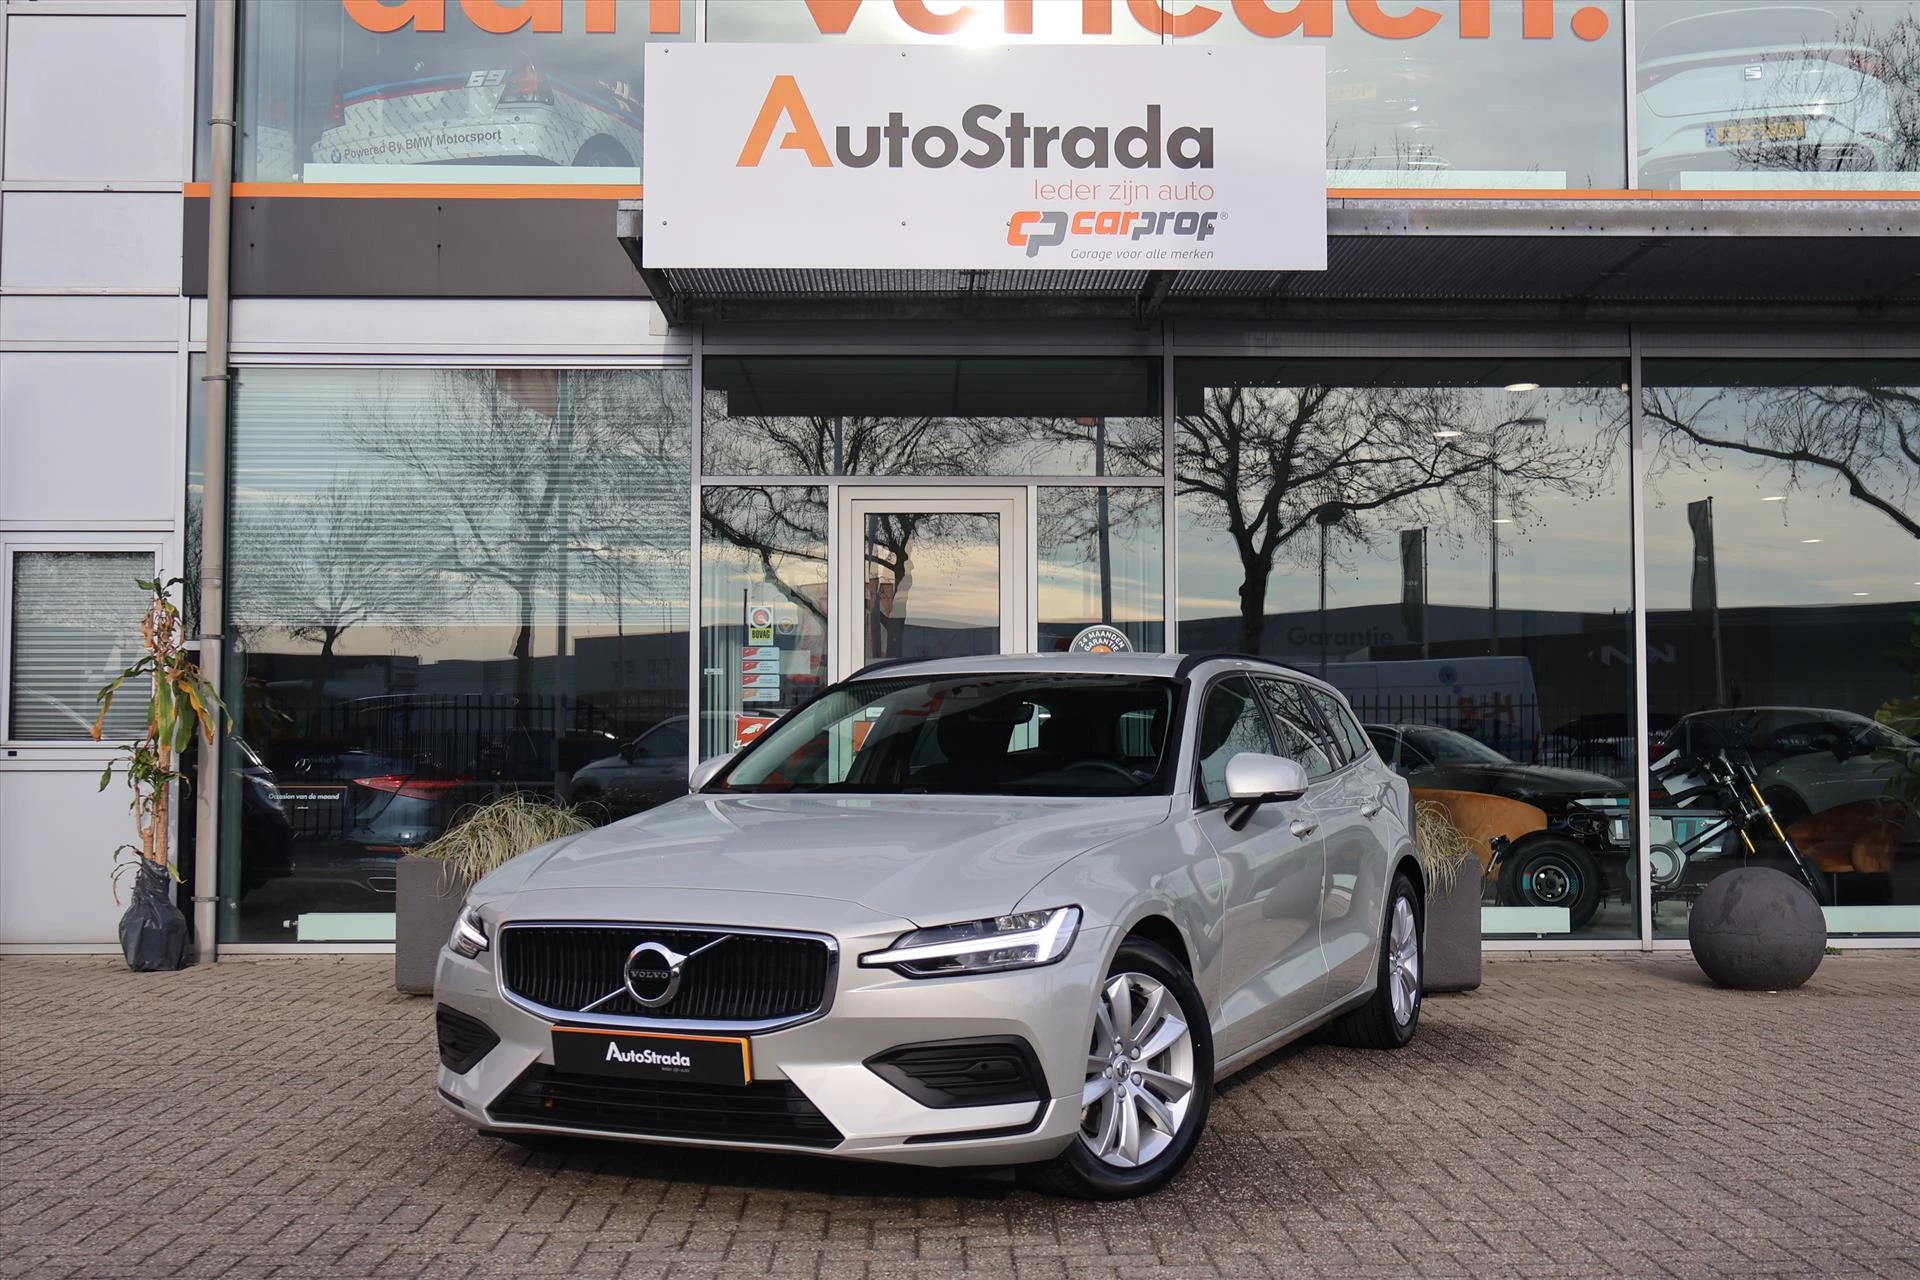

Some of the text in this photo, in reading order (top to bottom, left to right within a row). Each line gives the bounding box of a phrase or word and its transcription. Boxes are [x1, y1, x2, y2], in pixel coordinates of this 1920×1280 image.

[466, 70, 506, 87] 69
[736, 75, 1214, 170] AutoStrada
[343, 129, 503, 160] Powered By BMW Motorsport
[1034, 179, 1215, 206] Ieder zijn auto
[1070, 248, 1214, 261] Garage voor alle merken
[751, 629, 771, 639] BOVAG
[1079, 631, 1125, 648] 24 MAANDEN
[1286, 624, 1394, 647] Garantie
[1084, 638, 1119, 652] GARANTIE
[630, 970, 669, 979] VOLVO
[605, 1041, 691, 1067] AutoStrada
